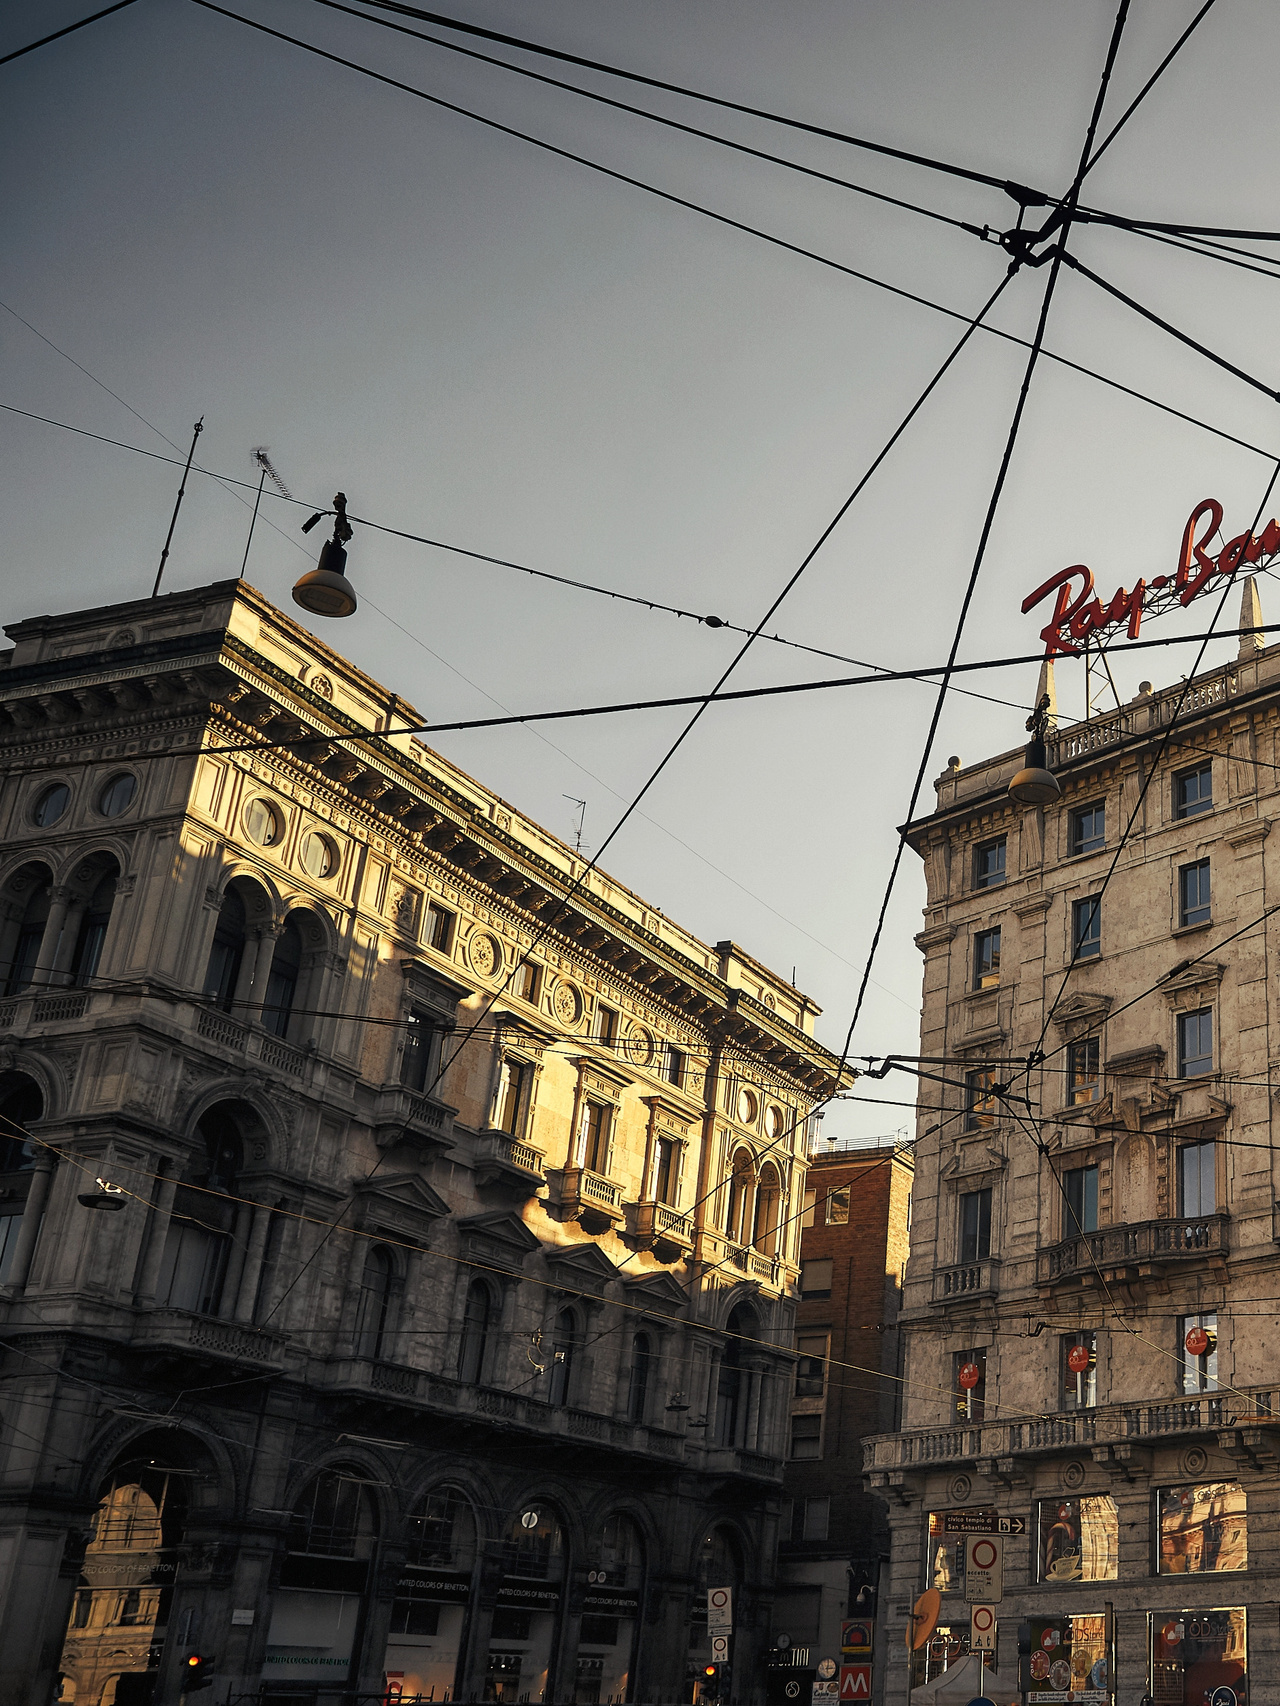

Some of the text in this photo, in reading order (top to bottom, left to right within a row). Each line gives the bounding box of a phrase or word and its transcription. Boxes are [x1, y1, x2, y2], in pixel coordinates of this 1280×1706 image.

[962, 1524, 992, 1533] Sebastiano
[98, 1565, 126, 1574] COLORS
[127, 1565, 136, 1573] OF
[137, 1563, 175, 1573] BENETTON
[396, 1579, 415, 1588] UNITED
[415, 1581, 437, 1589] COLORS
[444, 1583, 470, 1592] BENETTON
[497, 1588, 513, 1596] UNITED
[537, 1591, 560, 1600] BENETTON
[841, 1672, 869, 1693] M
